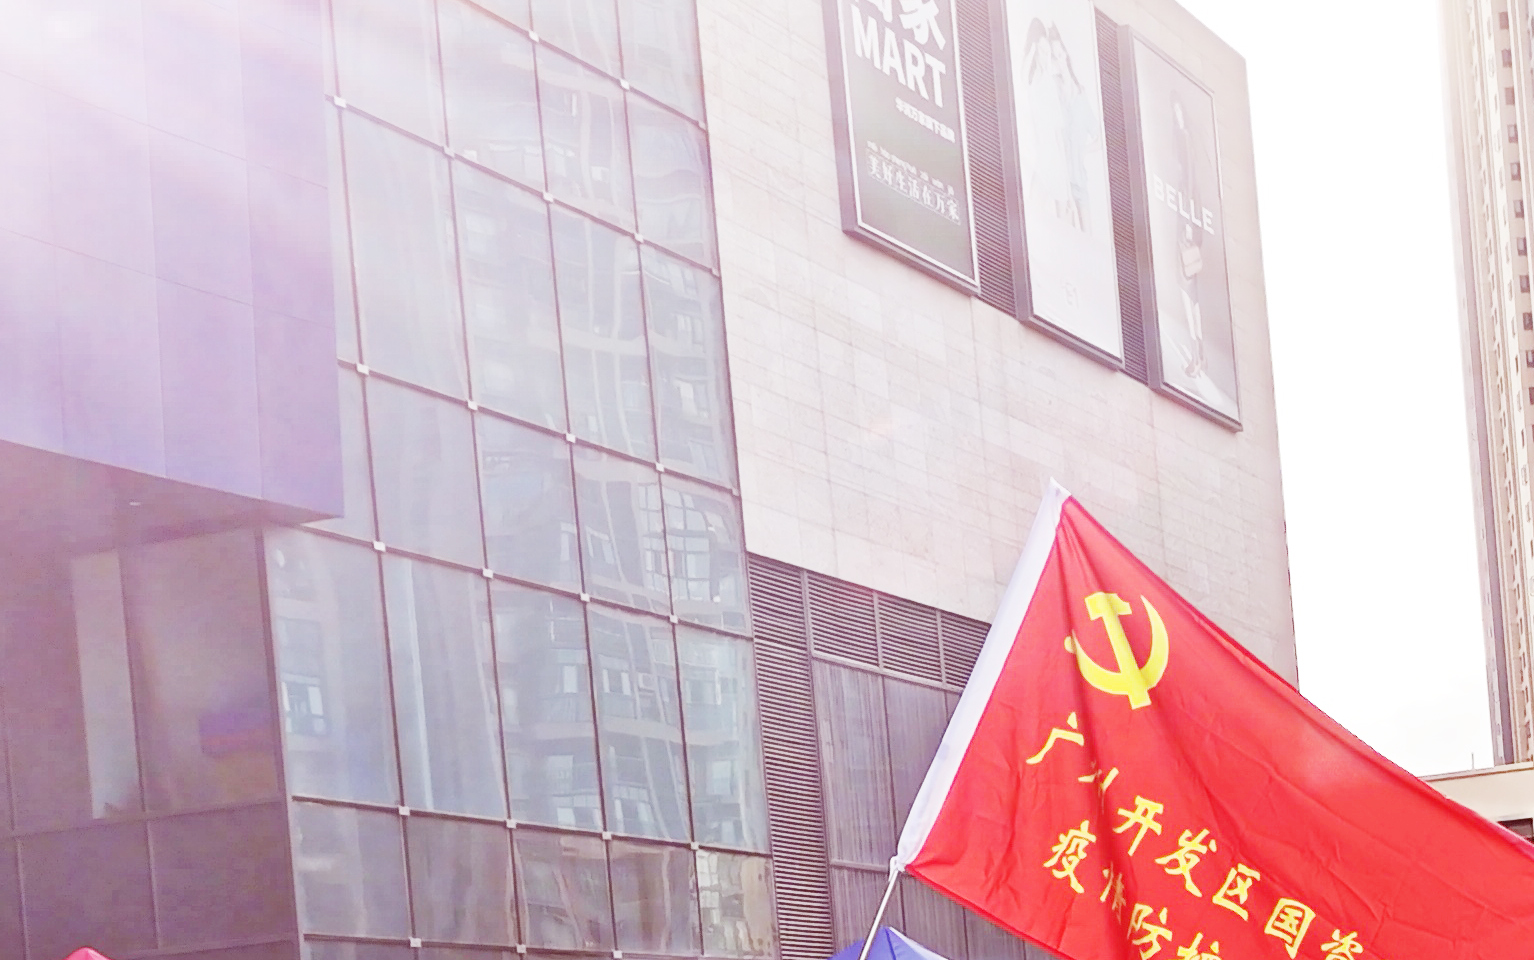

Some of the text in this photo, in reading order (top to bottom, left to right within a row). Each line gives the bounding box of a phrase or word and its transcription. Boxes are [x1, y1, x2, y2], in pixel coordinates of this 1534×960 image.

[851, 3, 946, 108] MART
[868, 154, 959, 221] 美好生活在万家
[1153, 173, 1215, 234] BELLE
